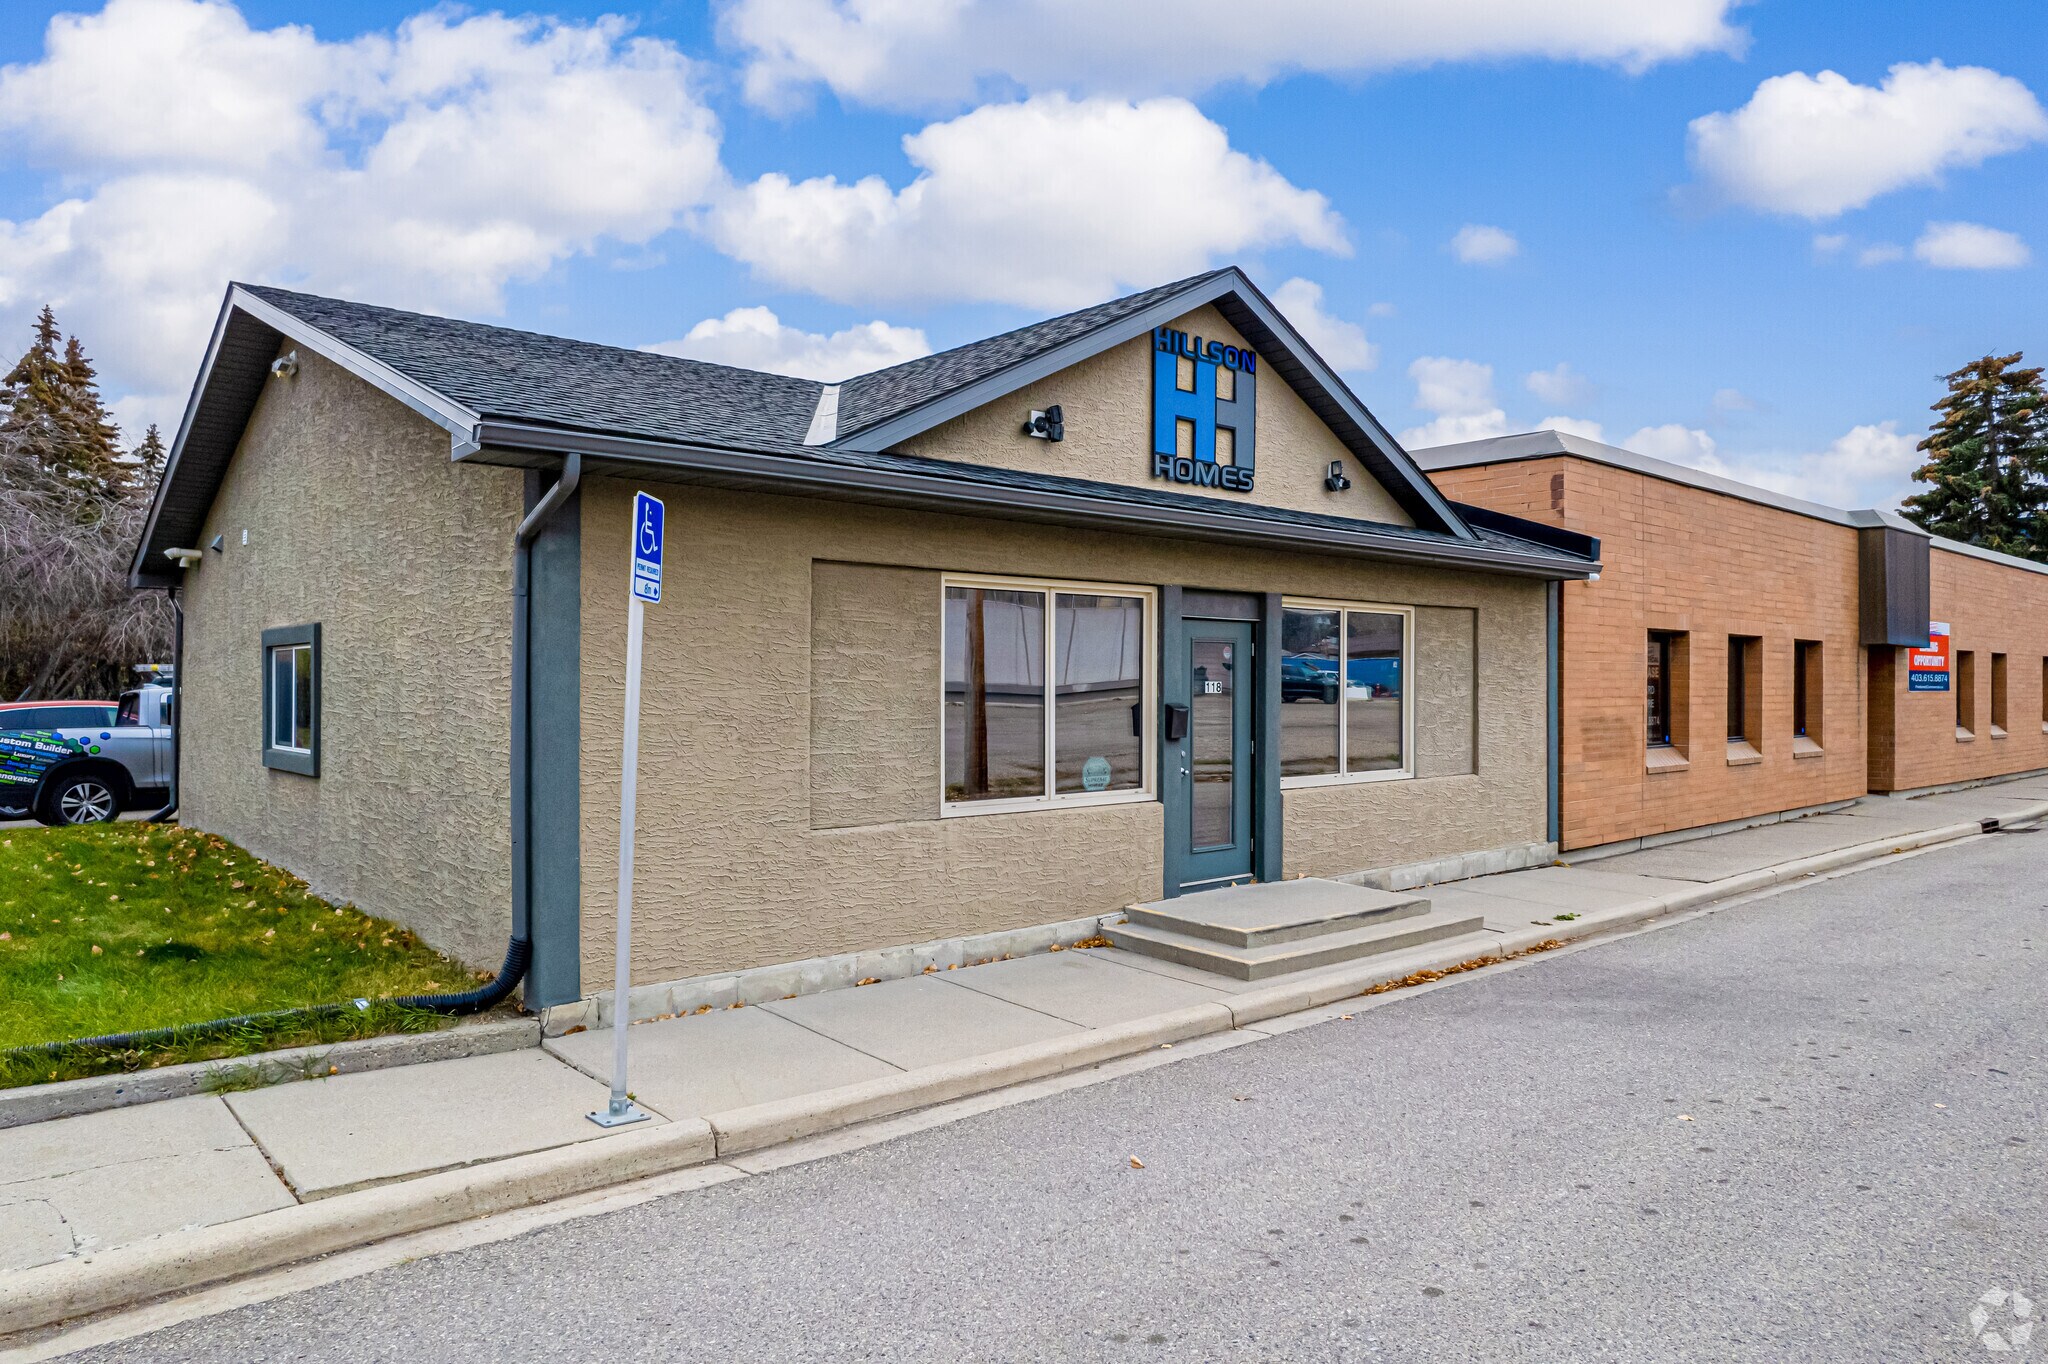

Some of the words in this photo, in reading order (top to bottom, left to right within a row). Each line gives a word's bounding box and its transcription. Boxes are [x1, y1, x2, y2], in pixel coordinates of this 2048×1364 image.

[1153, 327, 1256, 374] HILLSON
[1154, 453, 1254, 491] HOMES
[1914, 655, 1944, 666] OPPORTUNITY
[1206, 682, 1222, 692] 118
[35, 741, 74, 755] Builder
[13, 751, 36, 760] Luxury
[0, 773, 38, 783] novator
